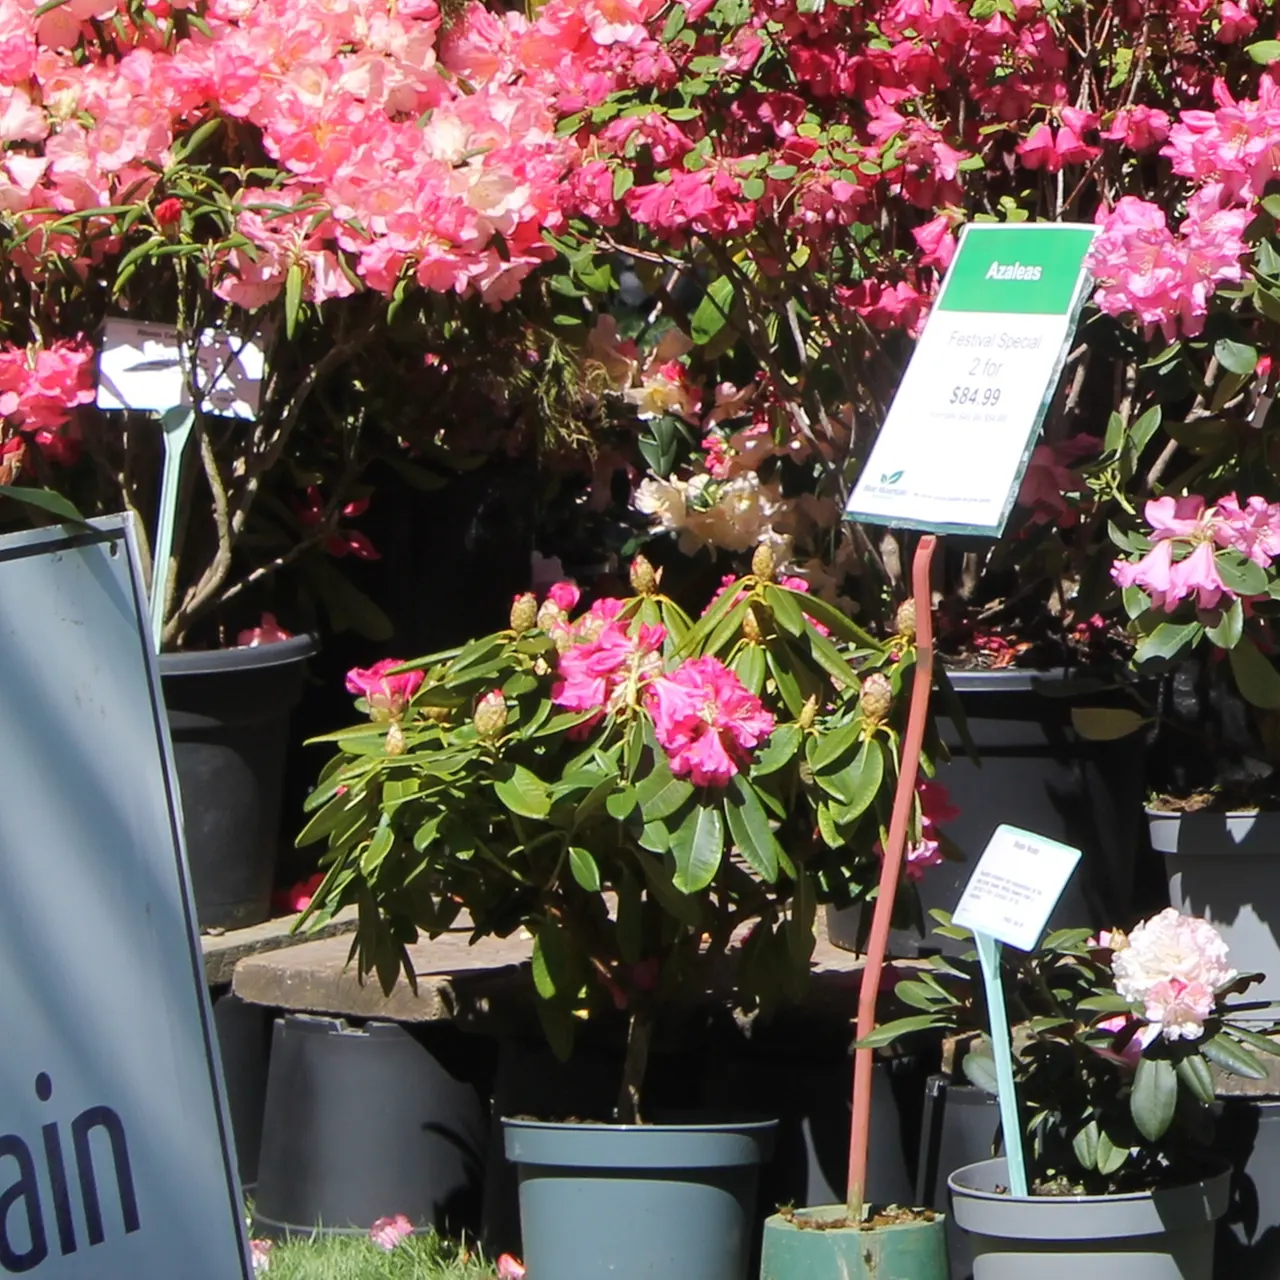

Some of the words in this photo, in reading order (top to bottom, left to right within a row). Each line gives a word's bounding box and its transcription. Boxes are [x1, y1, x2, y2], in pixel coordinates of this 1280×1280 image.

[985, 260, 1042, 281] Azaleas
[948, 330, 995, 349] Festival
[997, 332, 1043, 351] Special
[968, 357, 981, 377] 2
[982, 358, 1004, 378] for
[949, 385, 1002, 407] $84.99
